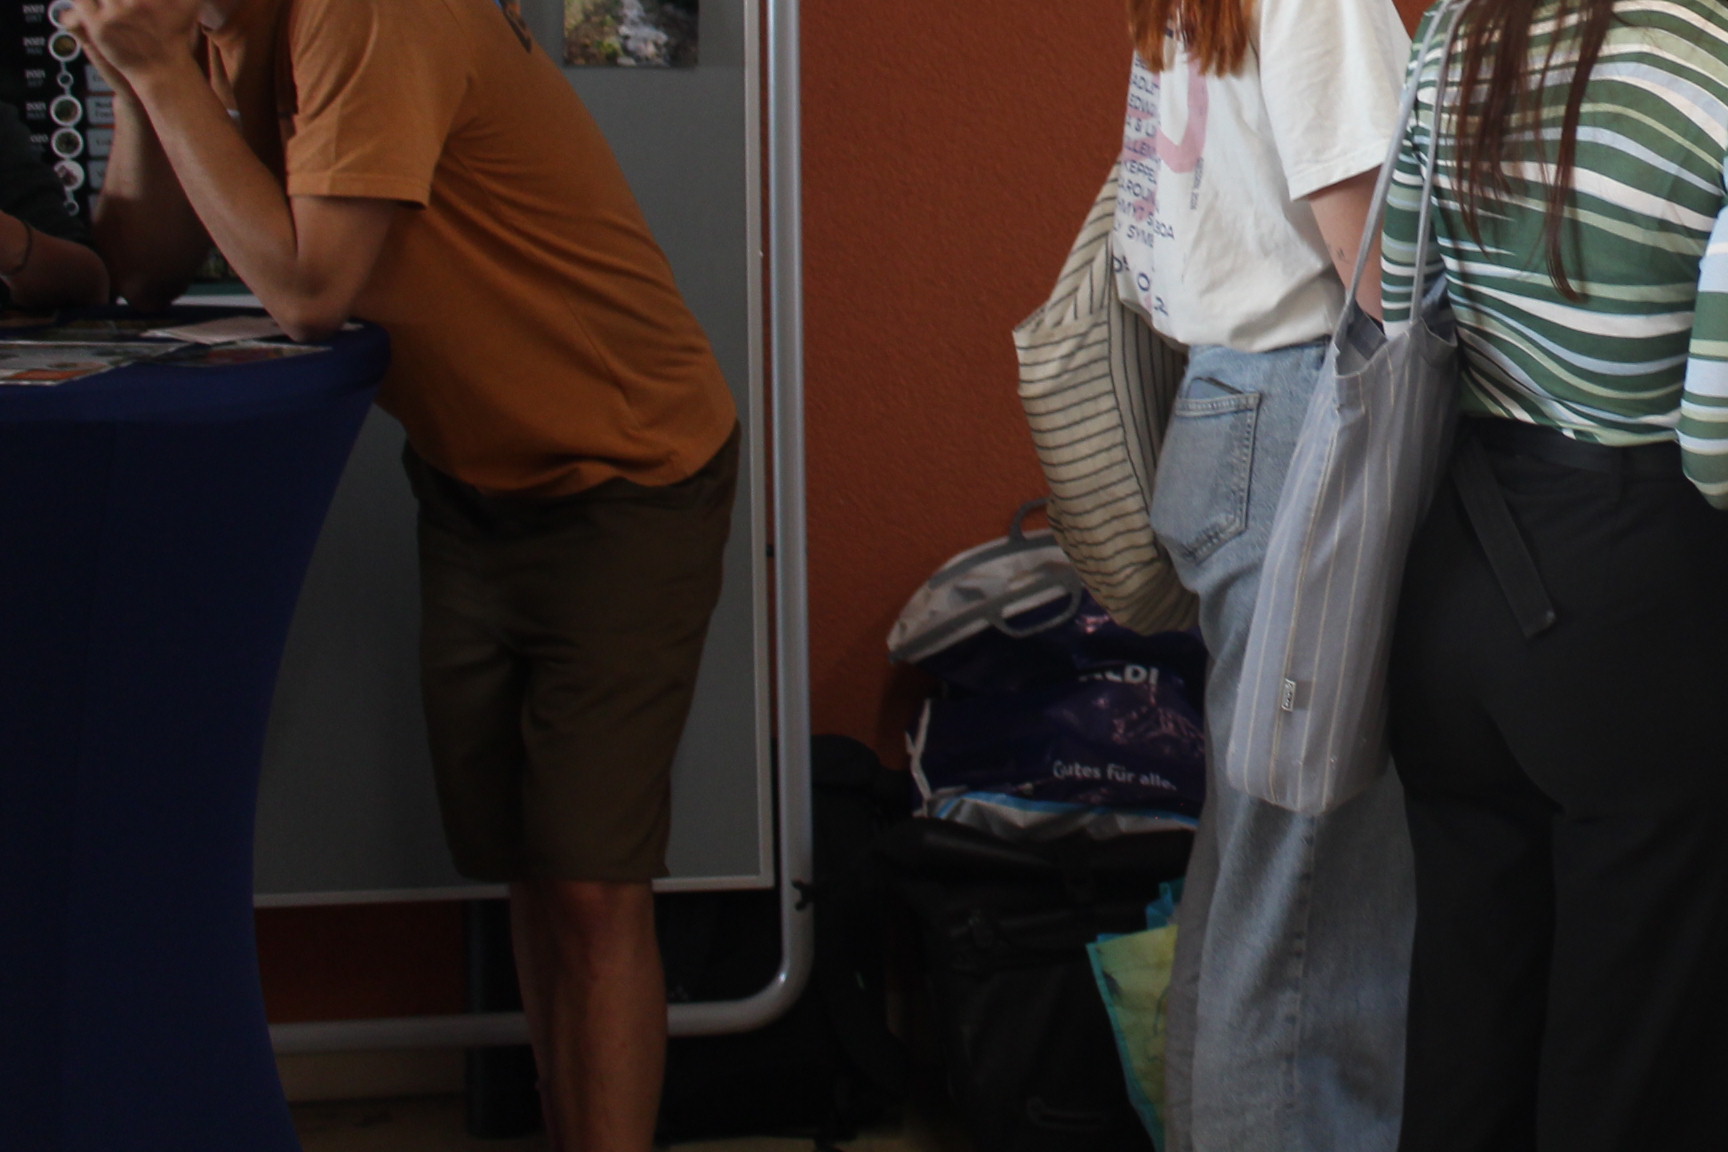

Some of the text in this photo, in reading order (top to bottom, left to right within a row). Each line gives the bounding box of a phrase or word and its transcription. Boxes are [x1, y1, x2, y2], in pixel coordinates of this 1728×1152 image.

[1053, 760, 1178, 792] Gutes für alle.
